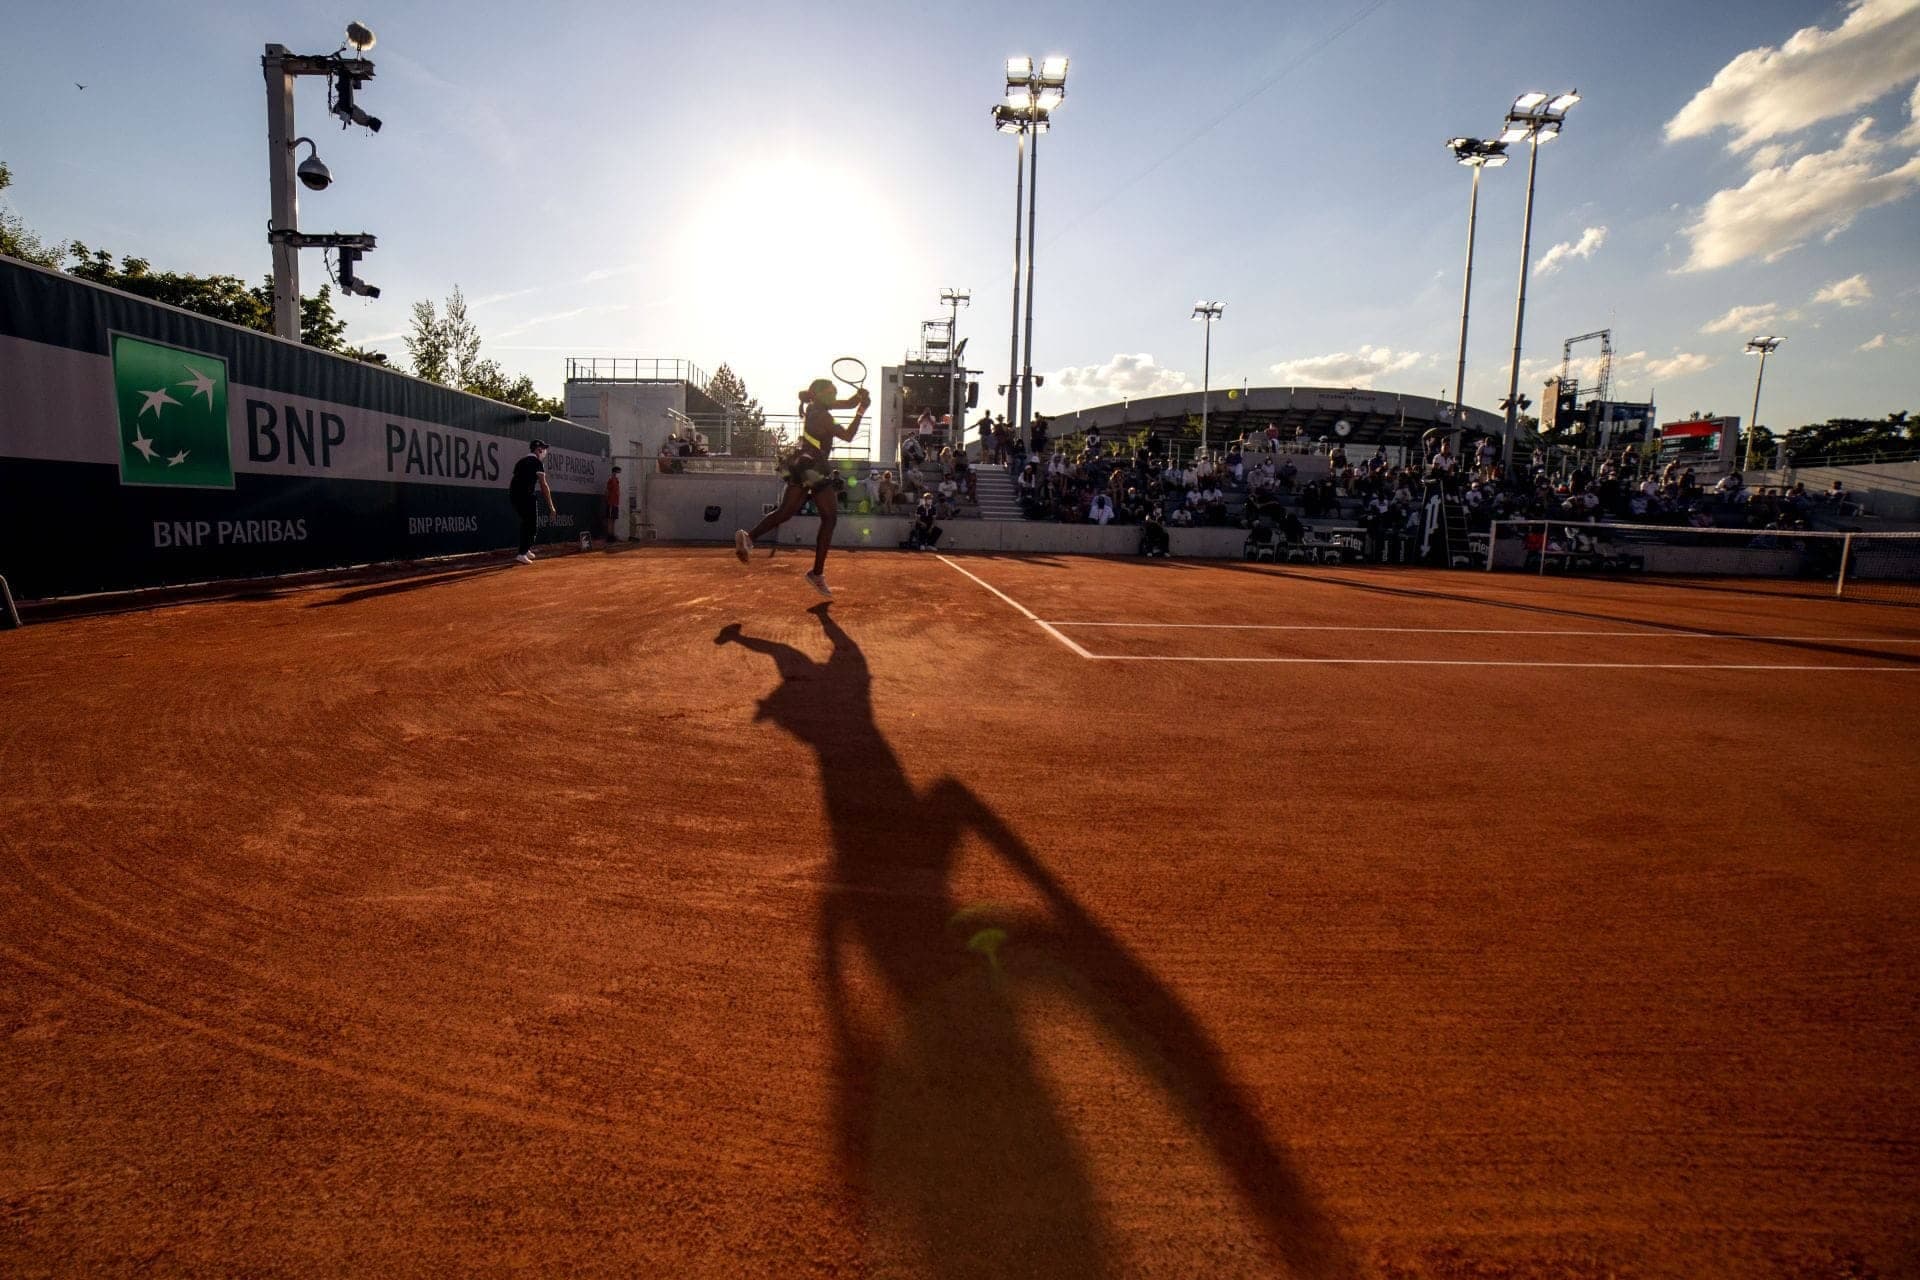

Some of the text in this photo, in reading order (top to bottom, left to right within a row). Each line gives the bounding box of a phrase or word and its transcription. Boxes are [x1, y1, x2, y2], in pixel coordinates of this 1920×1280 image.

[246, 399, 500, 482] BNP PARIBAS
[548, 453, 595, 475] BNP PARIBAS
[154, 519, 308, 548] BNP PARIBAS
[408, 515, 478, 535] BNP PARIBAS
